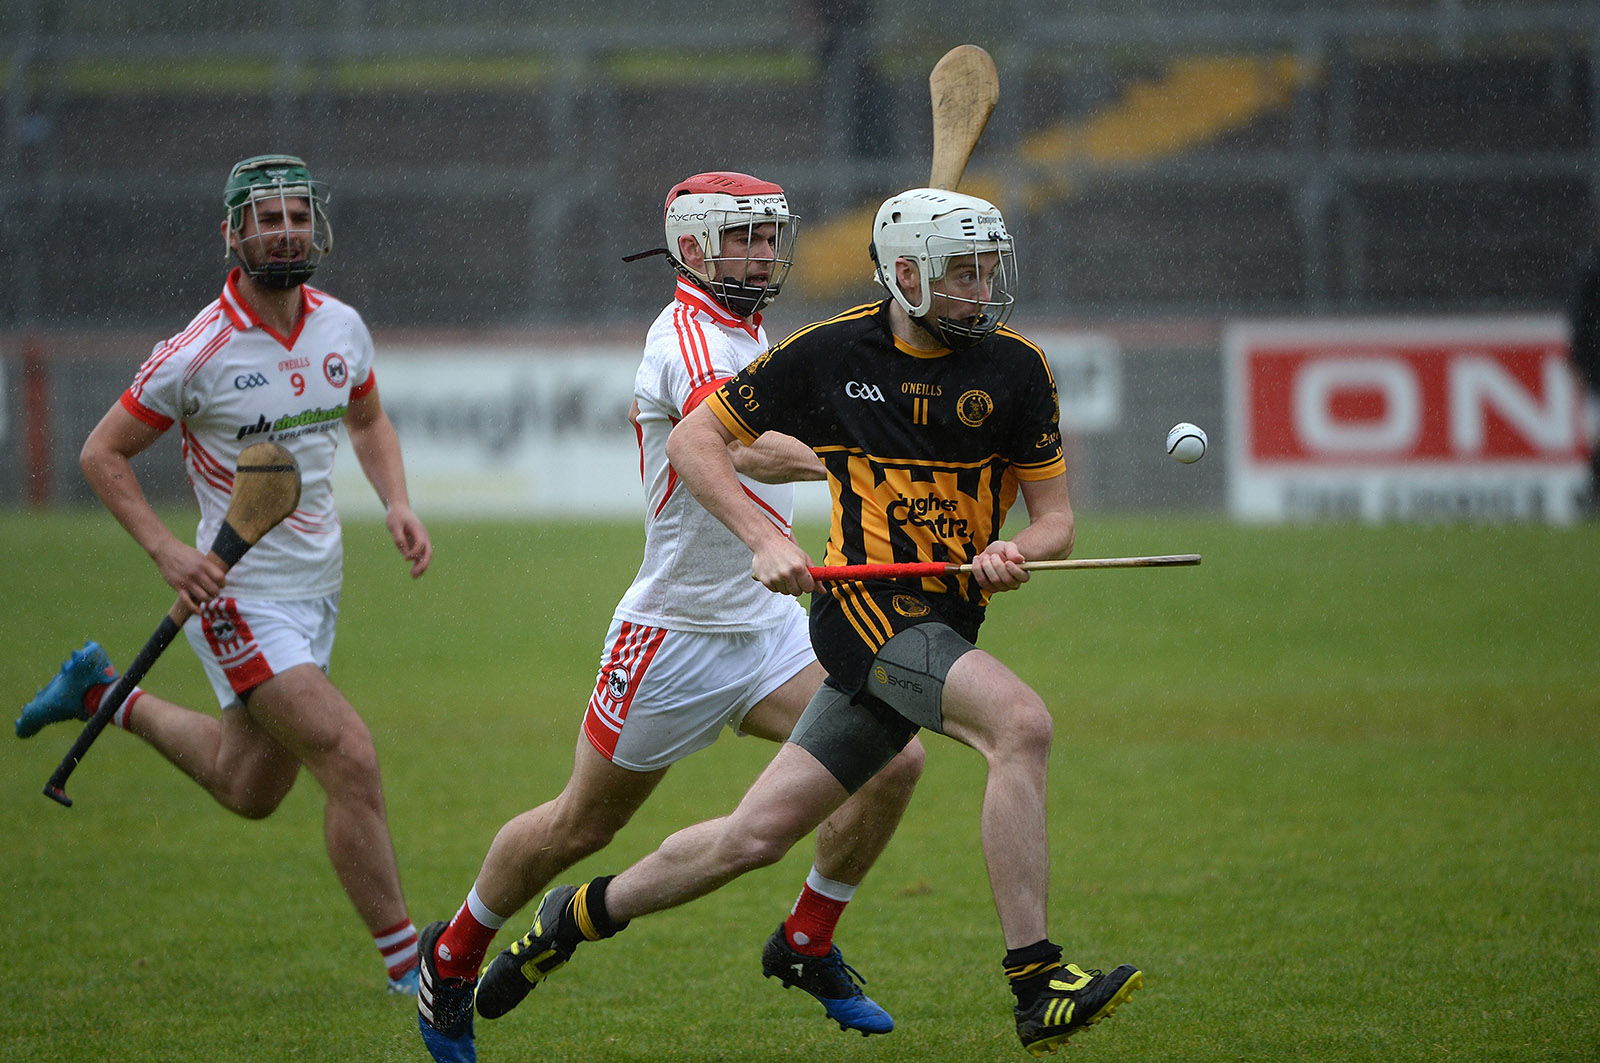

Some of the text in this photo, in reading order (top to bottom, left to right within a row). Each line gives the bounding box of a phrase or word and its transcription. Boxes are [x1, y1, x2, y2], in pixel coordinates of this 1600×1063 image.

[278, 357, 310, 373] O'NEILLS
[290, 372, 306, 397] 9
[845, 381, 886, 403] GAA
[901, 382, 943, 397] O'NEILLS
[913, 397, 929, 425] 11
[278, 425, 319, 442] SPRAYING
